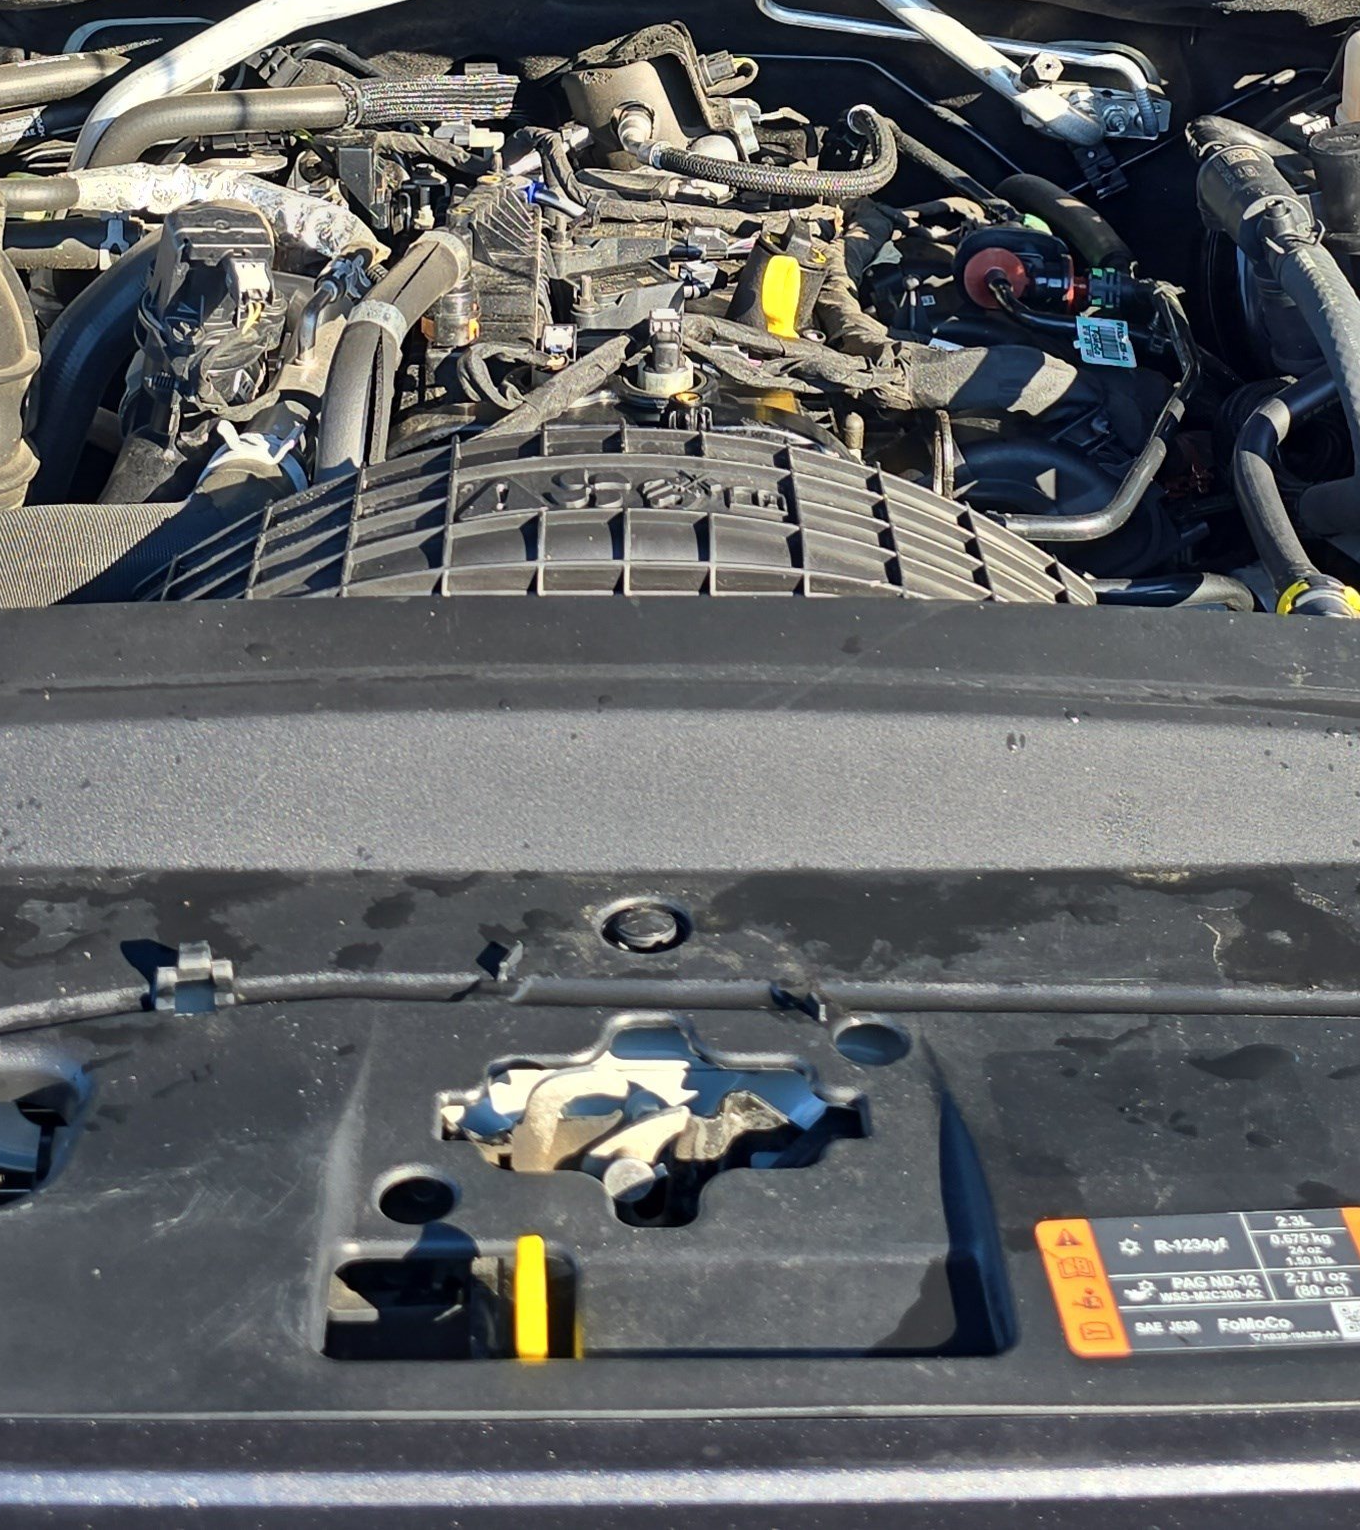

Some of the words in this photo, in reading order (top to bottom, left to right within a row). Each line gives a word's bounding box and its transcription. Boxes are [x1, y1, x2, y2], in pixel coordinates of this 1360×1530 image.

[1274, 1214, 1314, 1228] 2.3L
[1153, 1236, 1230, 1255] R-1234yf
[1269, 1233, 1309, 1249] 0.675
[1310, 1232, 1335, 1249] kg
[1287, 1245, 1305, 1256] 24
[1306, 1246, 1325, 1255] oz
[1285, 1256, 1313, 1267] 1.50
[1313, 1255, 1338, 1265] lbs
[1171, 1276, 1209, 1291] PAG
[1209, 1273, 1262, 1289] ND-12
[1283, 1271, 1310, 1287] 2.7
[1311, 1270, 1326, 1284] fl
[1327, 1272, 1352, 1283] oz
[1294, 1283, 1322, 1299] (80
[1322, 1282, 1354, 1297] cc)
[1134, 1321, 1165, 1336] SAE
[1217, 1315, 1295, 1335] FoMoCo
